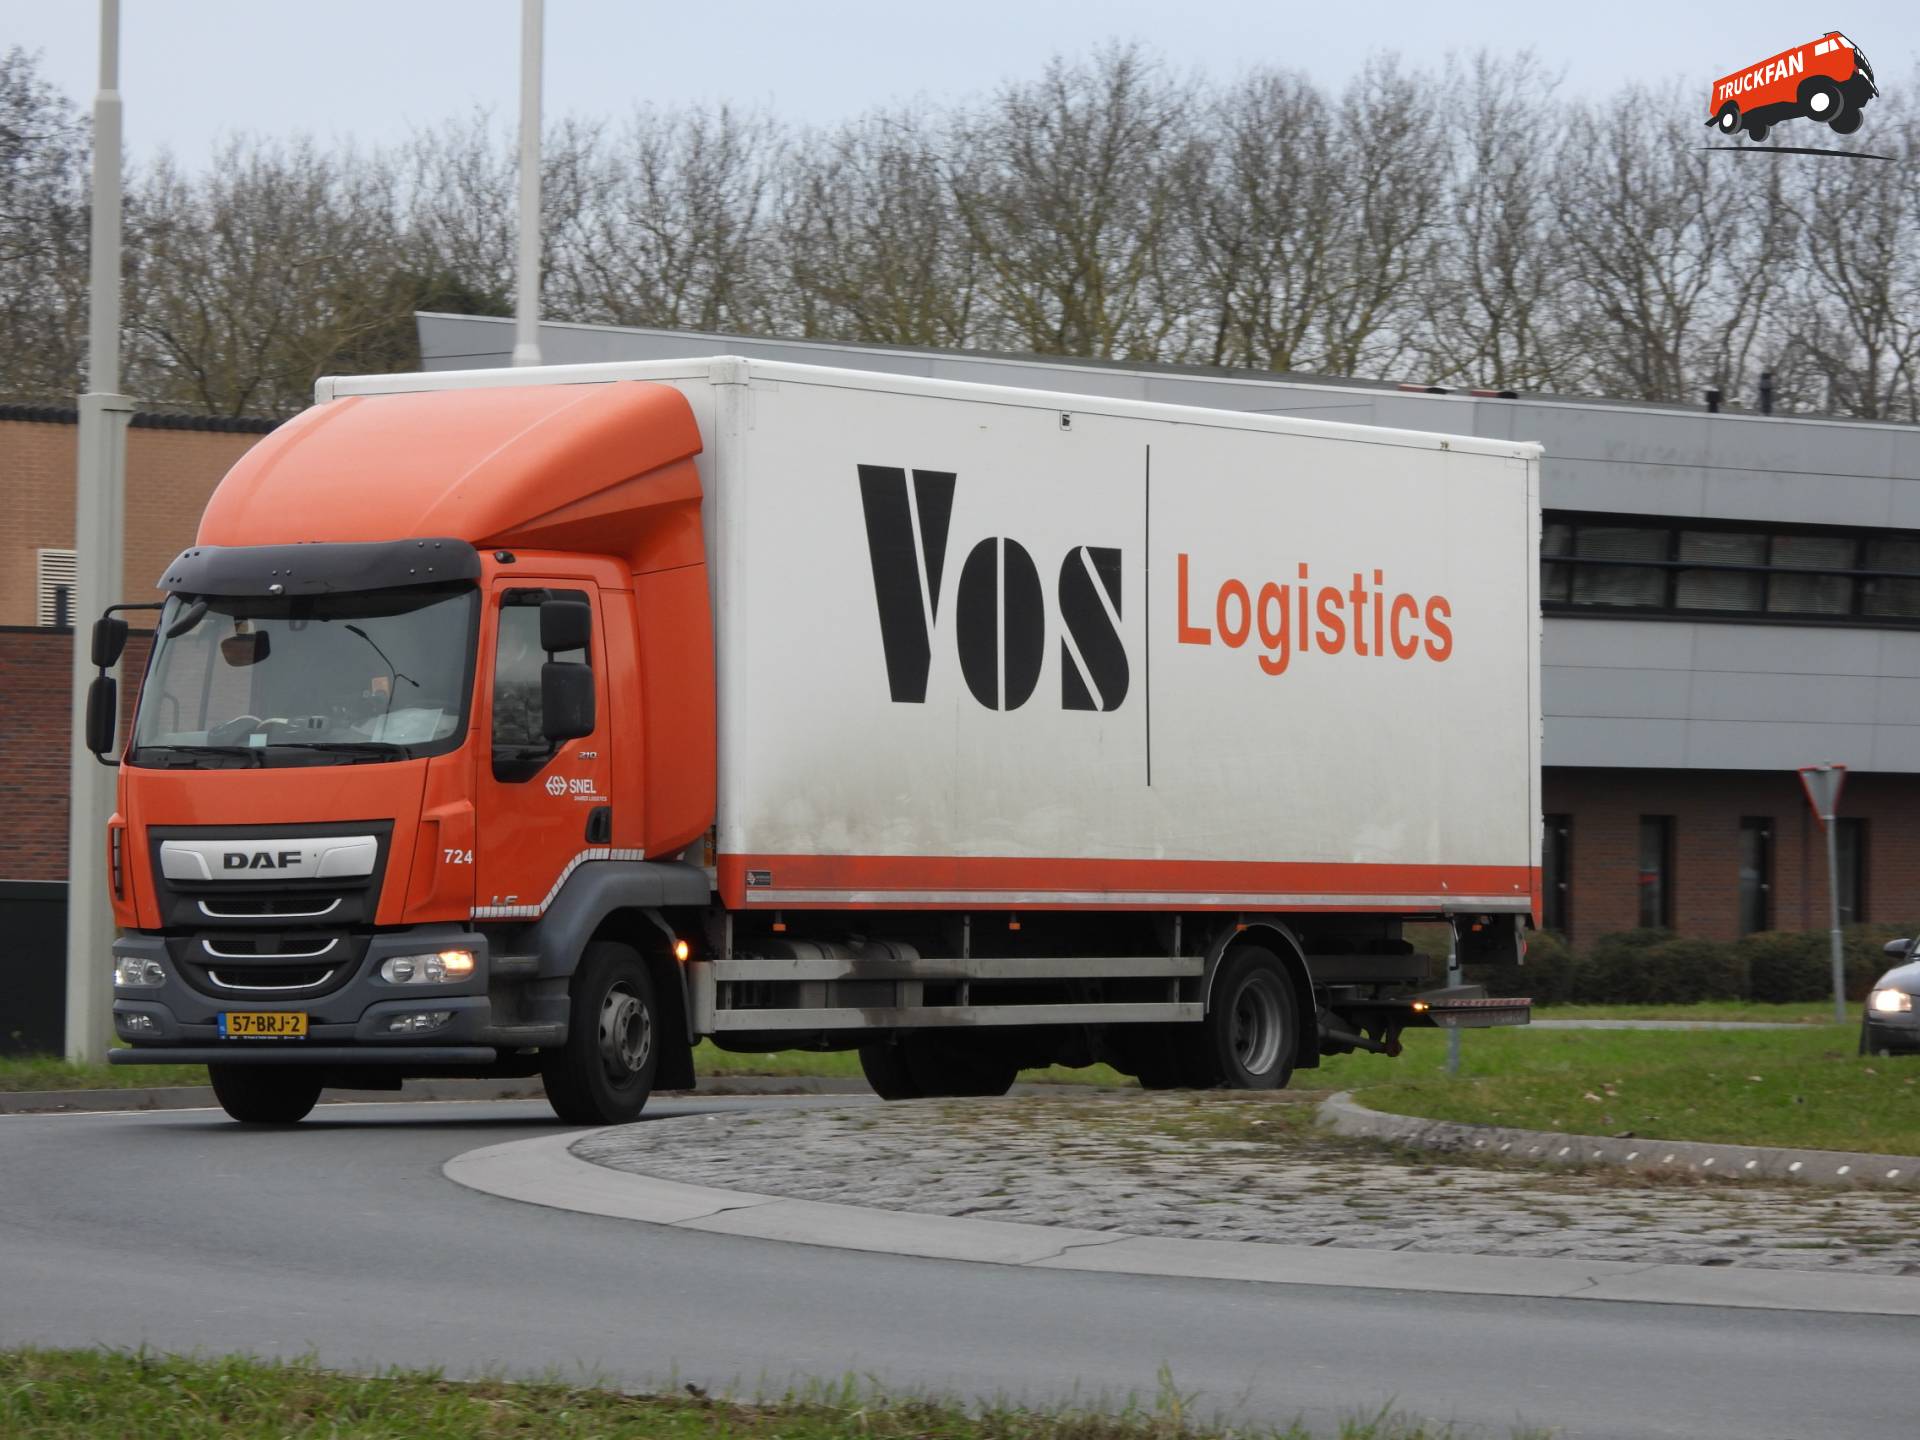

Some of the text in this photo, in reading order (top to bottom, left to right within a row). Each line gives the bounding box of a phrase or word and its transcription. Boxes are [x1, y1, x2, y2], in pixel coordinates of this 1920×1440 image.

[1177, 552, 1453, 676] Logistics
[569, 779, 597, 794] SNEL
[223, 851, 302, 869] DAF
[443, 848, 473, 864] 724
[232, 1015, 300, 1032] 57-BRJ-2
